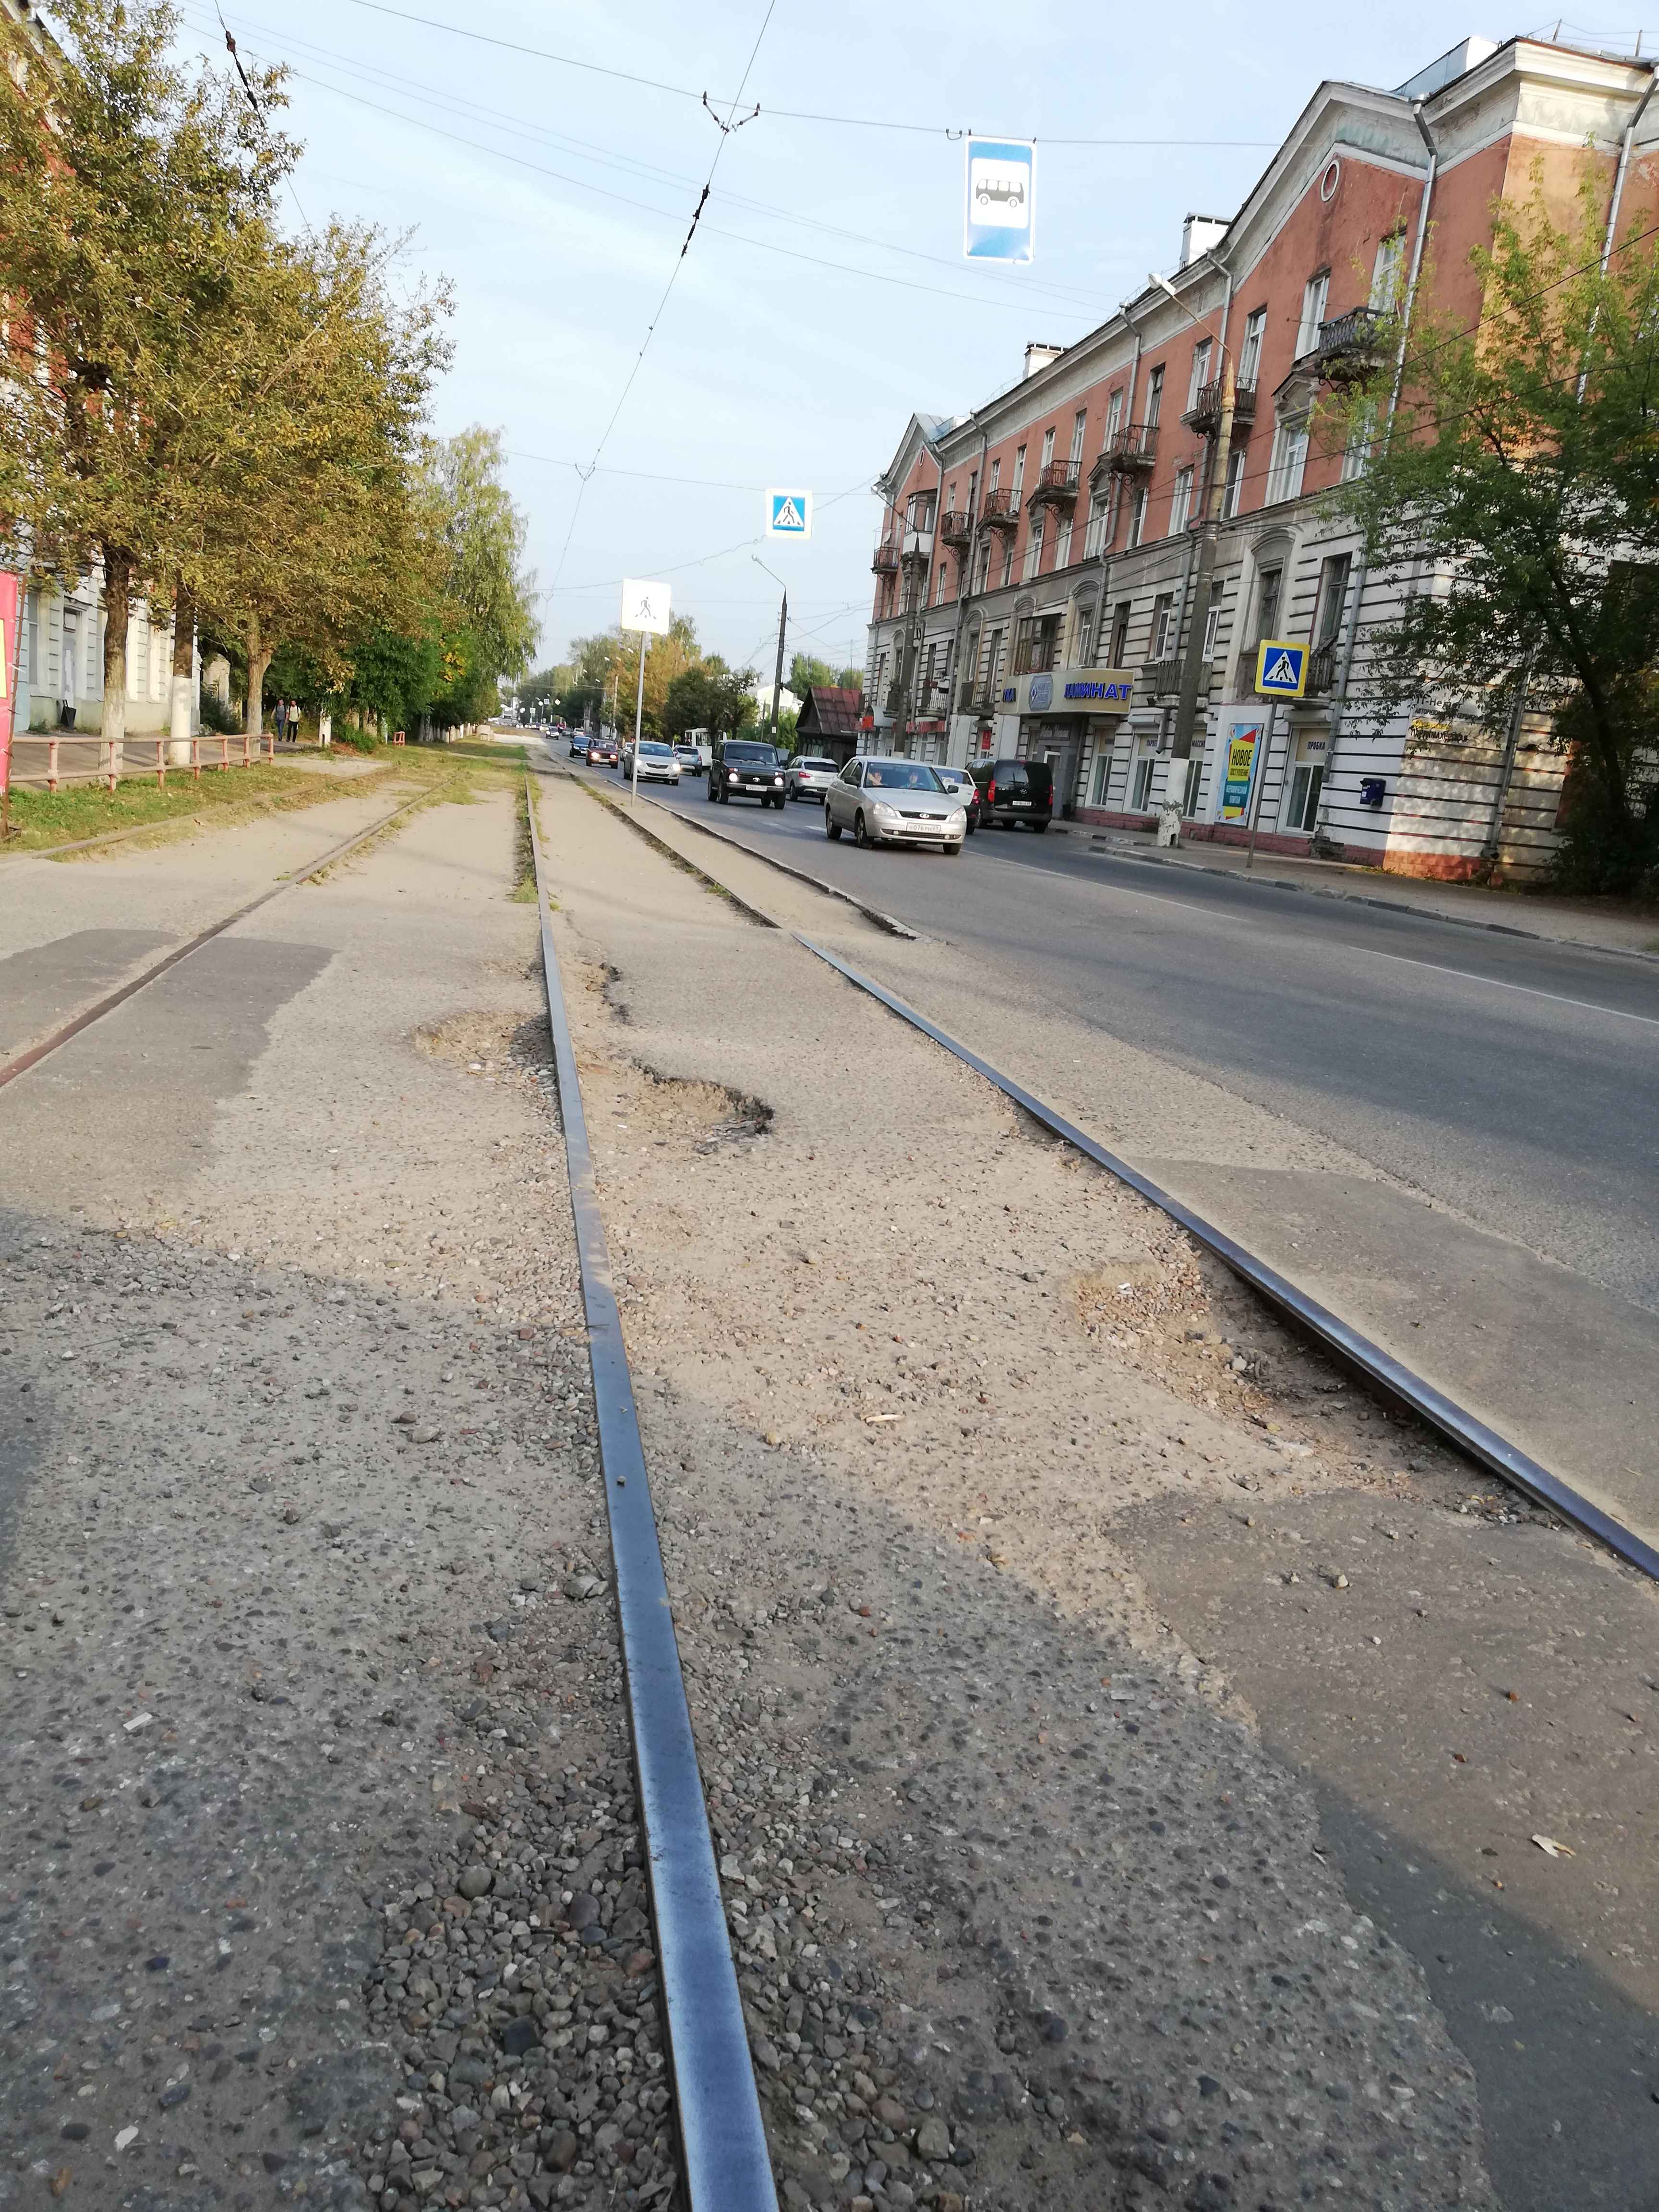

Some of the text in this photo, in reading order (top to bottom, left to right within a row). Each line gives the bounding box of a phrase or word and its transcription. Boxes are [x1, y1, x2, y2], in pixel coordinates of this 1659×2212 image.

[1063, 682, 1133, 700] ЛАМИНАТ
[1410, 728, 1468, 743] ПАРИКМАХЕРАЯ
[1307, 741, 1325, 750] ПРОБКА
[1231, 749, 1252, 767] НОВОЕ
